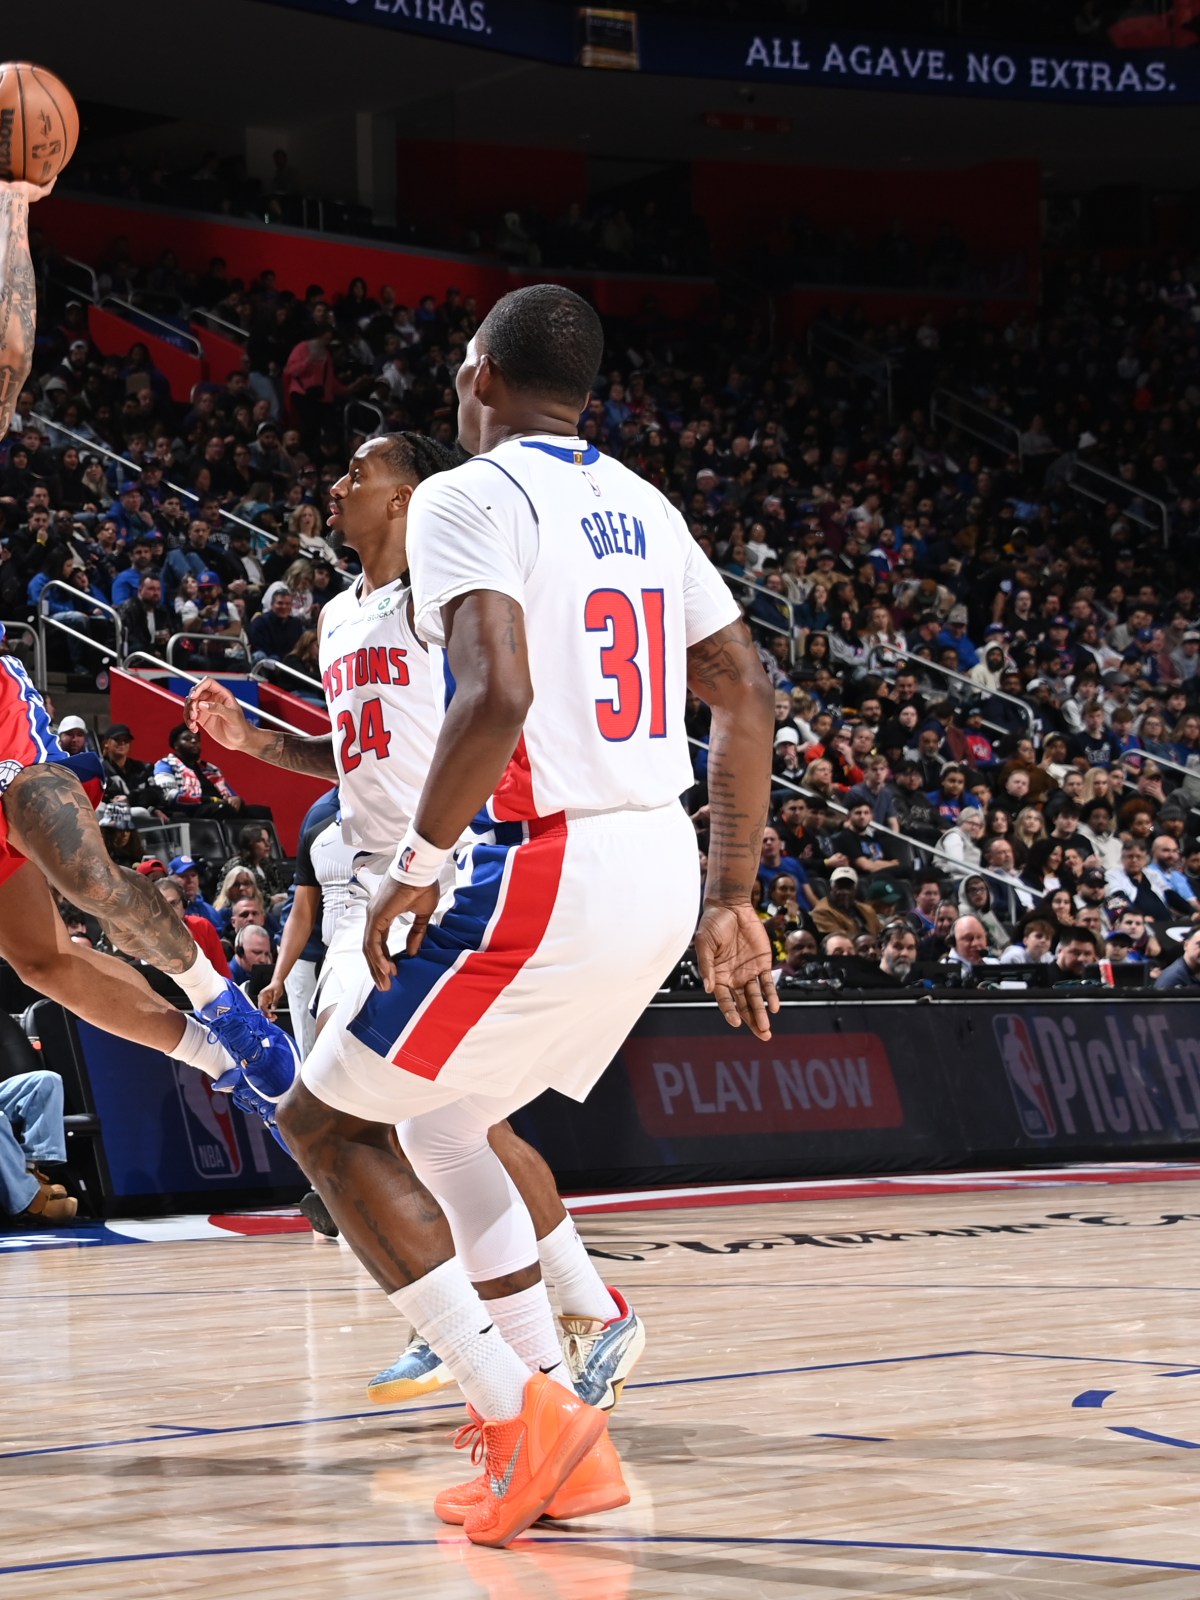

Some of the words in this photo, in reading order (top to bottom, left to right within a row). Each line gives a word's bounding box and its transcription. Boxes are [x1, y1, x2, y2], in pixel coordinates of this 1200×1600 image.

[745, 37, 809, 70] ALL
[822, 43, 954, 81] AGAVE.
[966, 53, 1016, 84] NO
[1029, 57, 1177, 92] EXTRAS.
[580, 510, 647, 560] GREEN
[584, 587, 668, 743] 31
[337, 697, 392, 775] 24
[652, 1060, 763, 1115] PLAY
[772, 1057, 873, 1110] NOW
[198, 1144, 225, 1169] NBA
